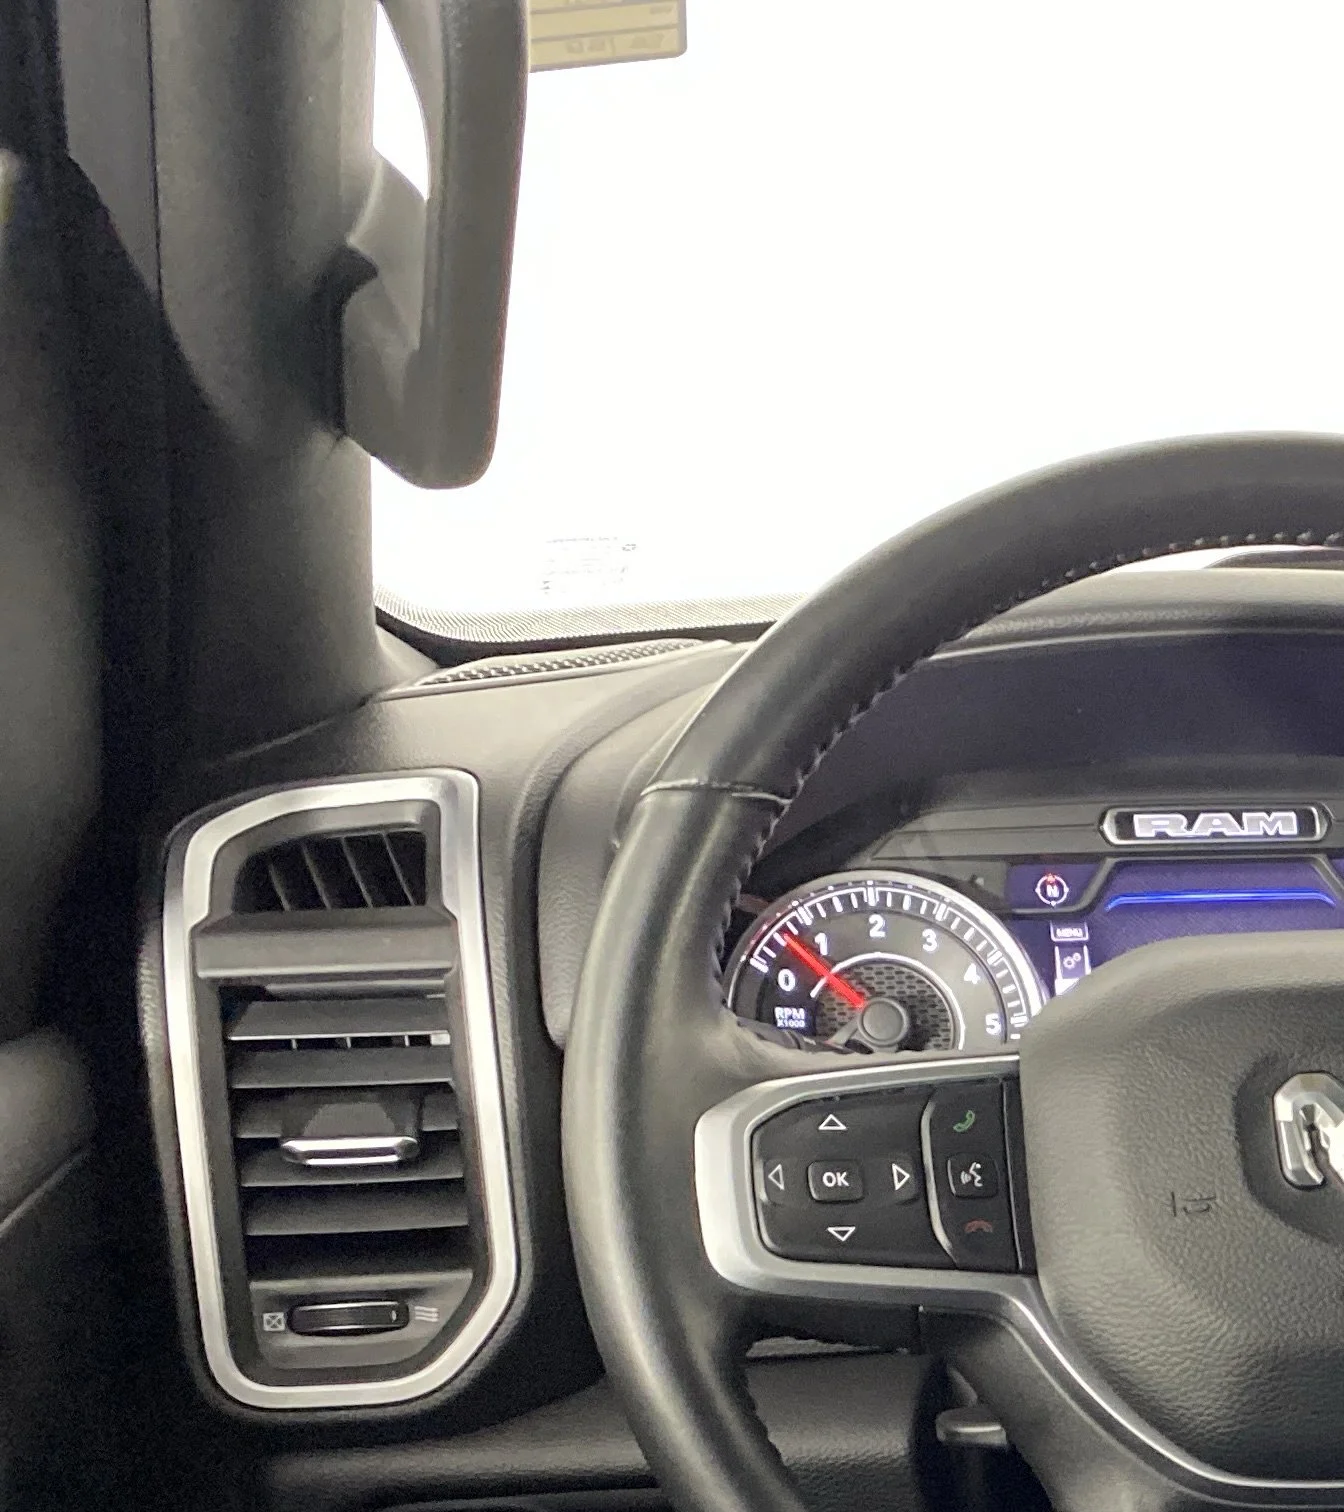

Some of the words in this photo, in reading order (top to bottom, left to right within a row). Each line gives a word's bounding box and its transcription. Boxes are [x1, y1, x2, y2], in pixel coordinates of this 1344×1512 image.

[1133, 812, 1298, 837] RAM
[1046, 884, 1059, 897] N
[868, 914, 885, 938] 2
[814, 932, 828, 955] 1
[922, 929, 938, 951] 3
[778, 968, 796, 991] 0
[964, 964, 980, 984] 4
[774, 1007, 805, 1020] RPM
[985, 1013, 1001, 1035] 5
[822, 1171, 850, 1188] OK
